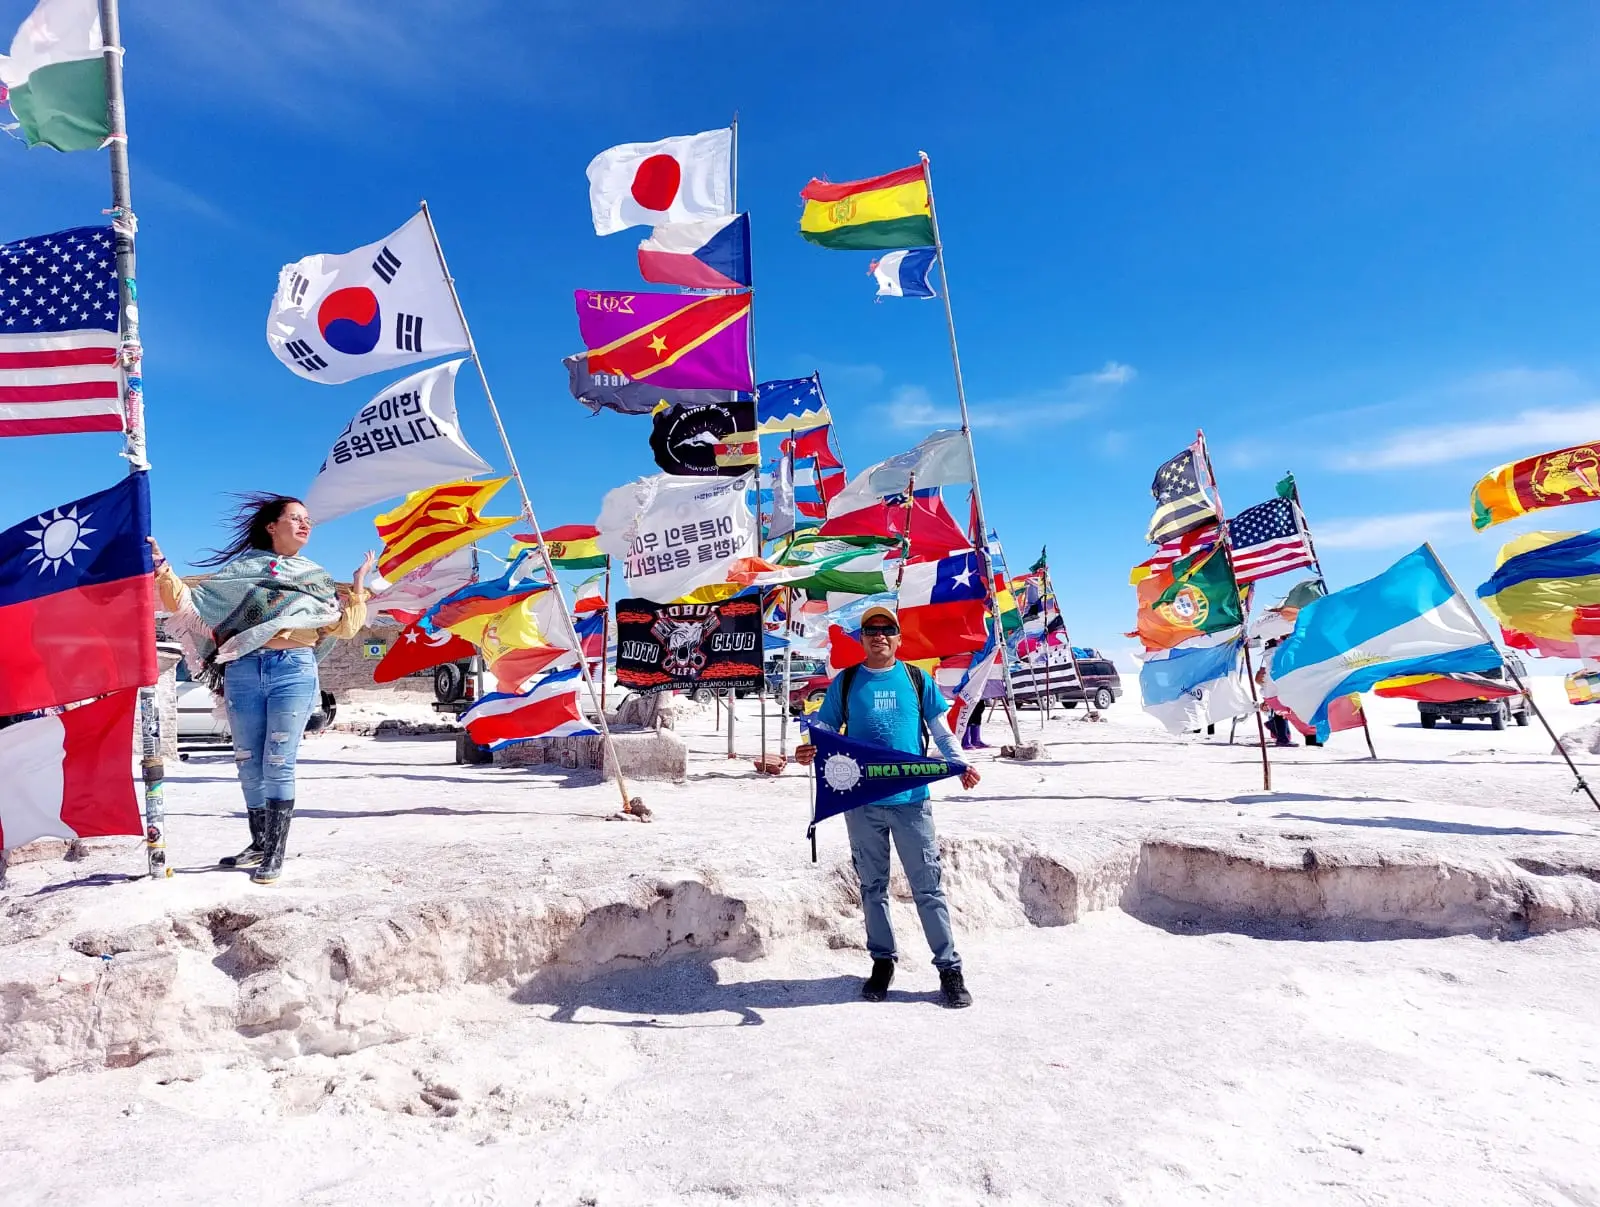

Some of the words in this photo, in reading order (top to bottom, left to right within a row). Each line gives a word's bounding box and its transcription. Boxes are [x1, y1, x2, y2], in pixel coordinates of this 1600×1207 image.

[360, 391, 421, 425] 우아한
[622, 640, 660, 664] MOTO
[711, 632, 756, 652] CLUB
[670, 667, 697, 676] ALFA
[867, 765, 900, 777] INCA
[901, 763, 948, 776] TOURS
